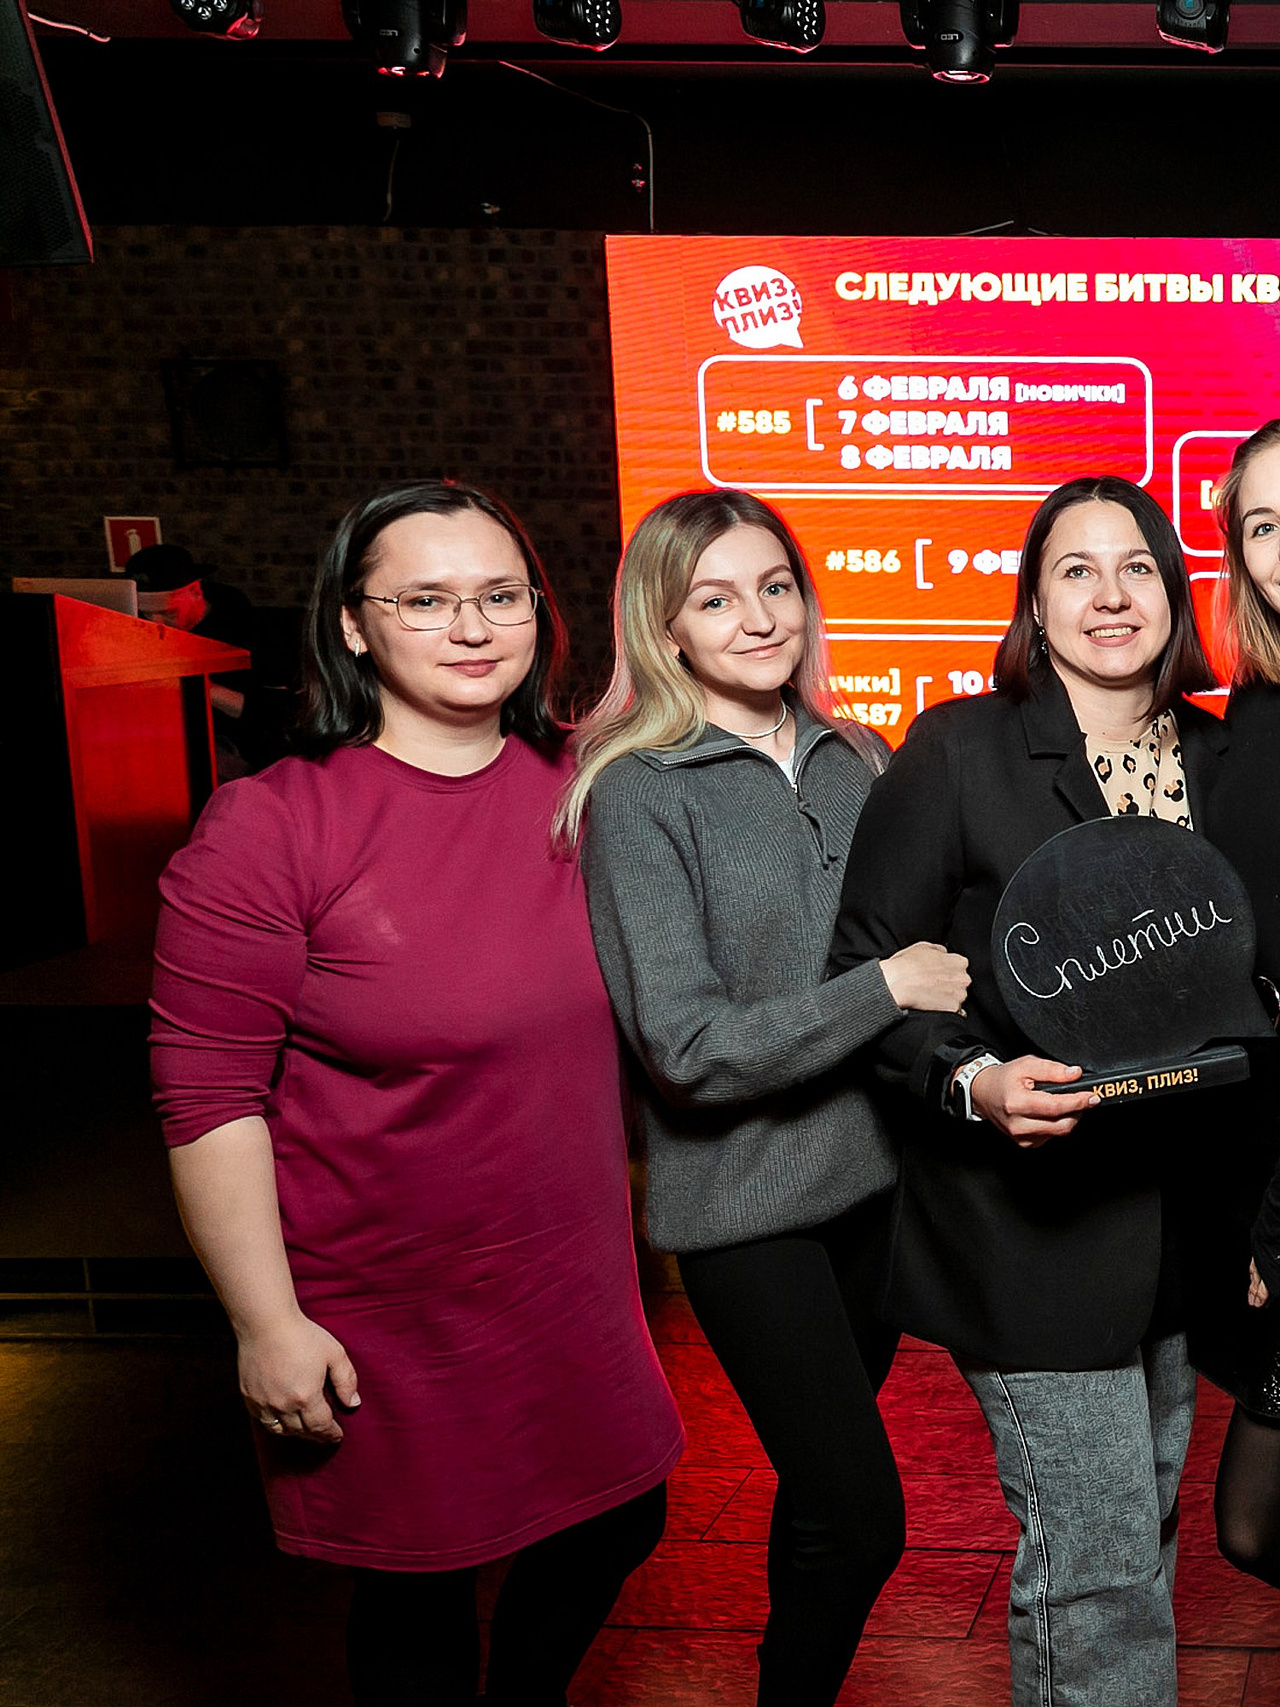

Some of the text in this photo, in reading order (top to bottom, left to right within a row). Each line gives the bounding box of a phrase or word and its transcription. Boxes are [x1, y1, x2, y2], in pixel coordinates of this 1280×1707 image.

[835, 271, 1088, 306] СЛЕДУЮЩИЕ
[1095, 273, 1224, 303] БИТВЫ
[720, 299, 802, 337] ПЛИЗ!
[838, 376, 859, 400] 6
[862, 375, 1010, 401] ФЕВРАЛЯ
[717, 411, 791, 434] #585
[838, 410, 1009, 435] 7 ФЕВРАЛЯ
[840, 444, 1012, 470] 8 ФЕВРАЛЯ
[826, 549, 901, 573] #586
[948, 550, 968, 574] 9
[948, 670, 984, 695] 10
[1092, 1068, 1199, 1098] КВИЗ, ПЛИЗ!
